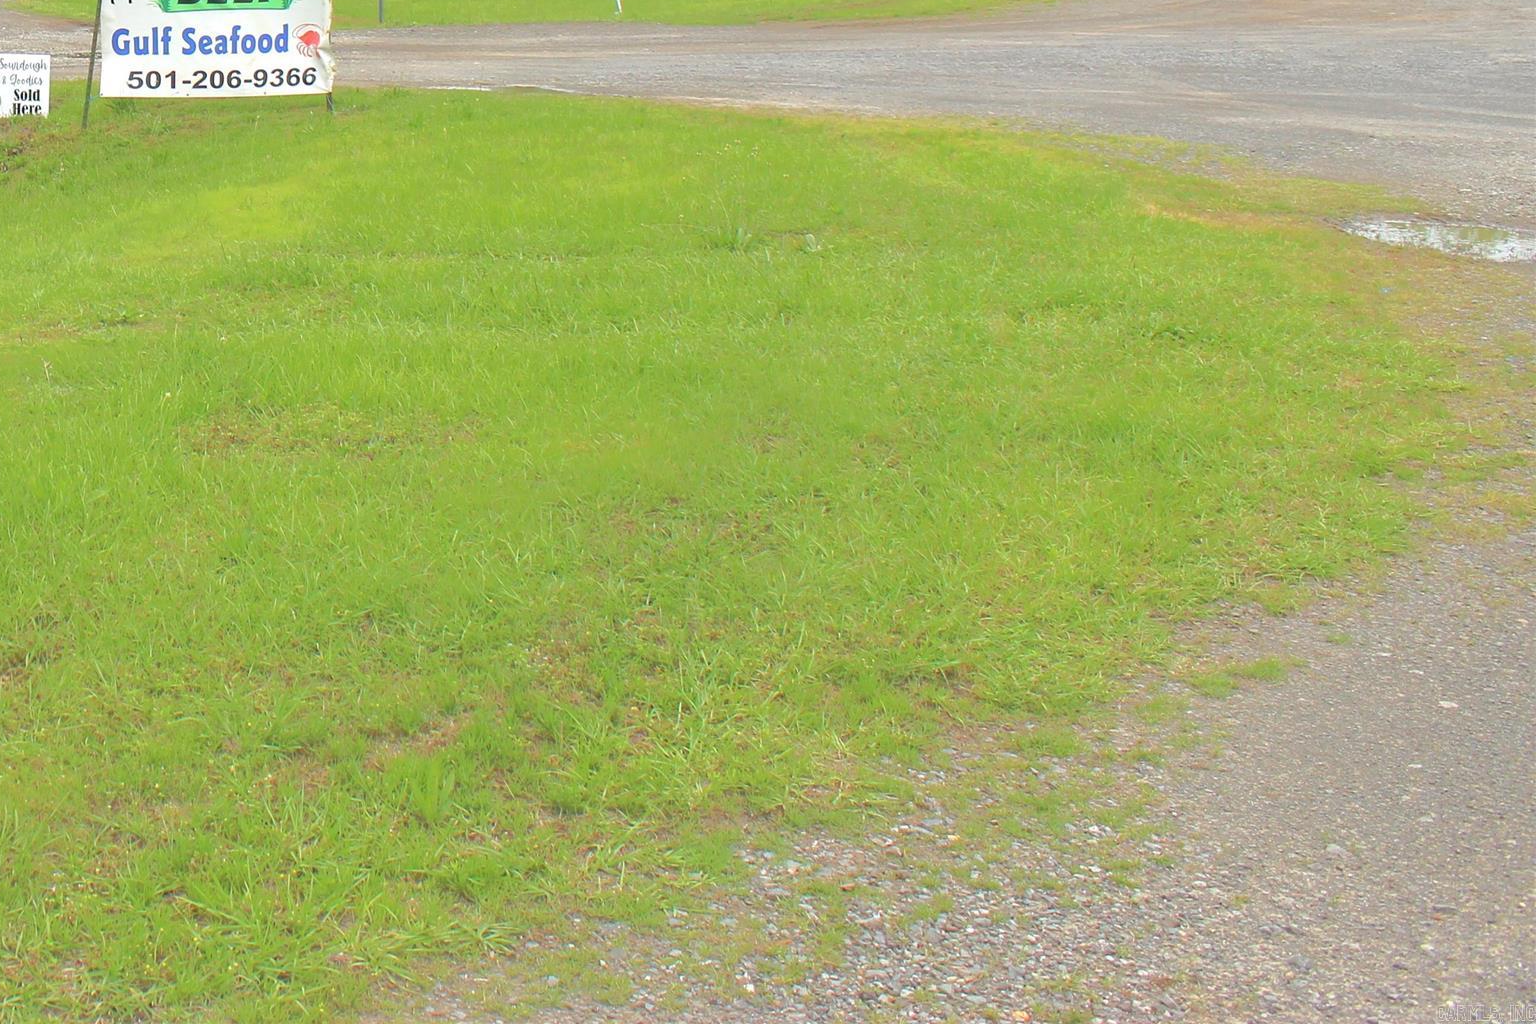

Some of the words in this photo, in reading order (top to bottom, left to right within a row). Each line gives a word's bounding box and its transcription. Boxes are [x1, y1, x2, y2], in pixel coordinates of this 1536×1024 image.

[111, 26, 173, 56] Gulf
[181, 23, 289, 56] Seafood
[0, 57, 48, 73] Sourdough
[9, 73, 43, 86] Goodies
[127, 67, 317, 90] 501-206-9366
[13, 88, 41, 102] Sold
[12, 102, 42, 116] Here
